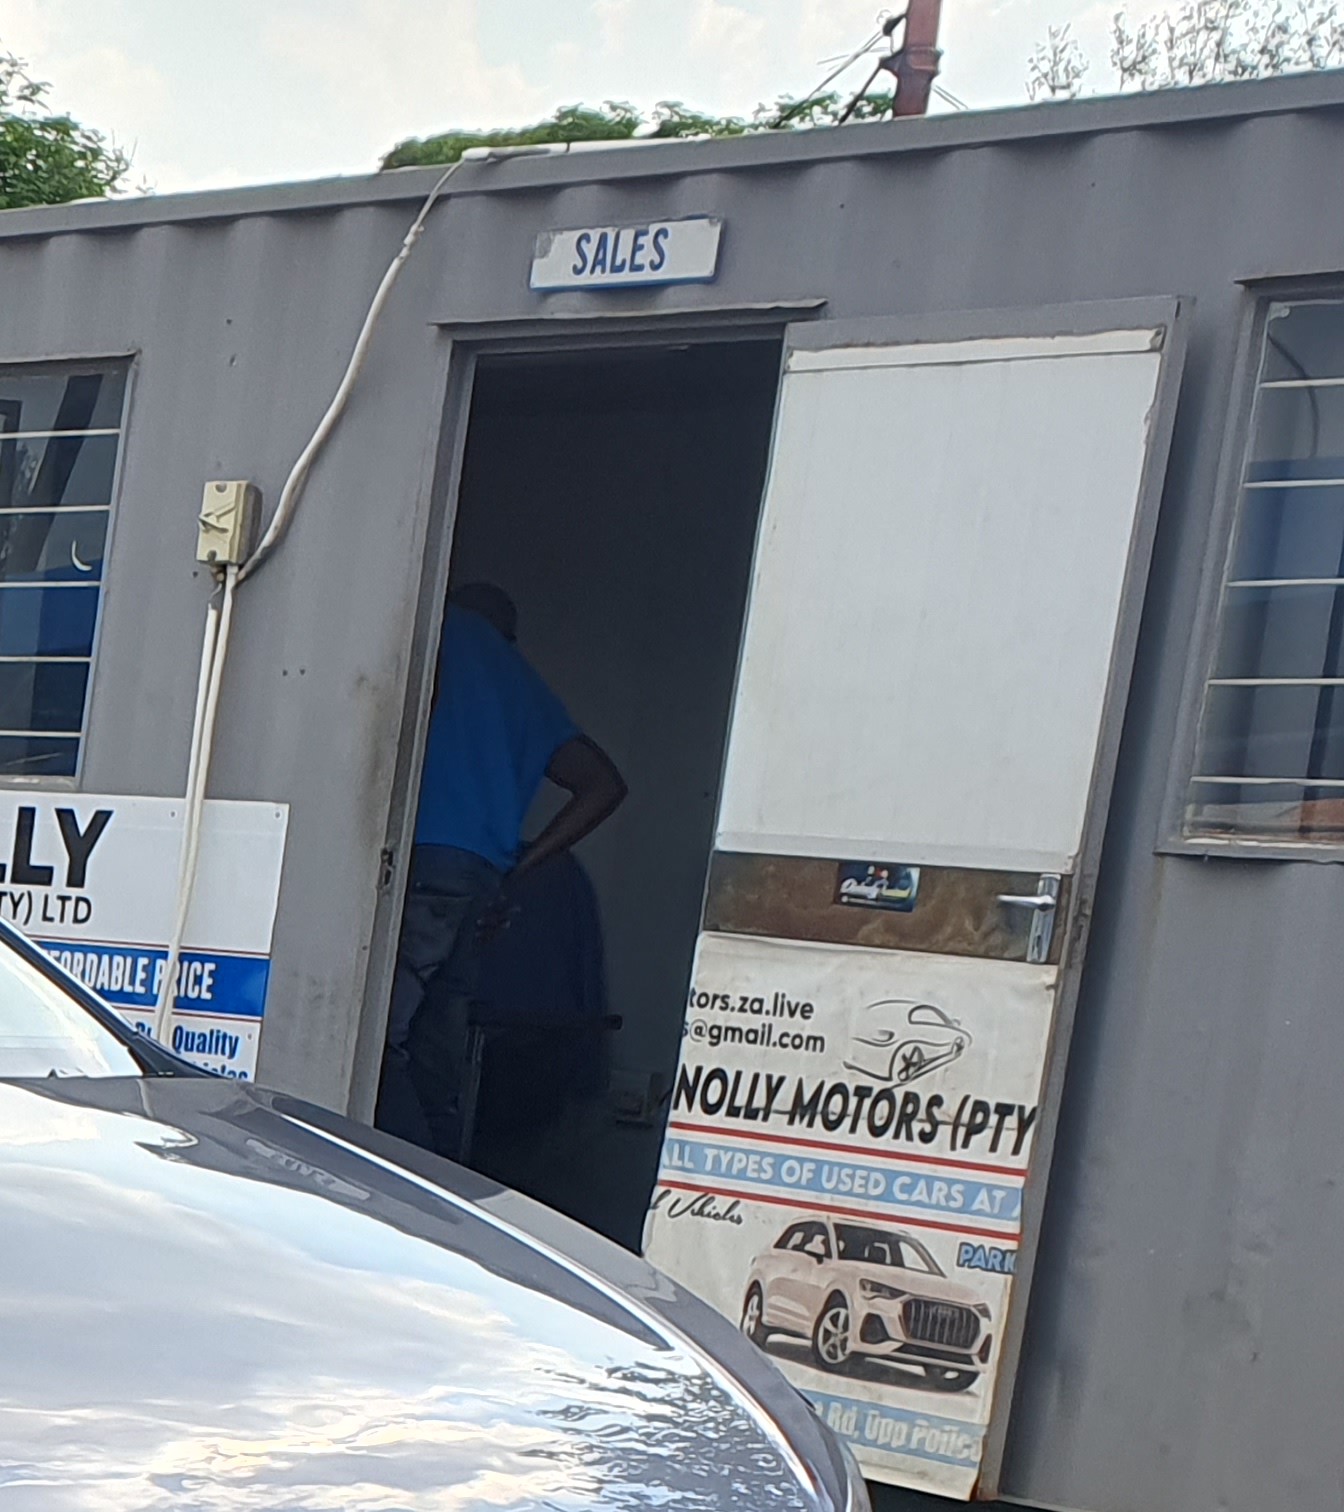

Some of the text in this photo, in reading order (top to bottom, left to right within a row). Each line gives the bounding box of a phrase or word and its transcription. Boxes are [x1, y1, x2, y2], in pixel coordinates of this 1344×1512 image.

[572, 227, 669, 276] SALES
[41, 893, 92, 924] LTD
[172, 1025, 240, 1060] Quality
[673, 1062, 1037, 1157] NOLLY MOTORS (PTY
[703, 1148, 774, 1181] TYPES
[780, 1162, 816, 1187] OF
[820, 1168, 886, 1197] USED
[892, 1176, 964, 1209] CARS
[974, 1188, 1009, 1215] AT
